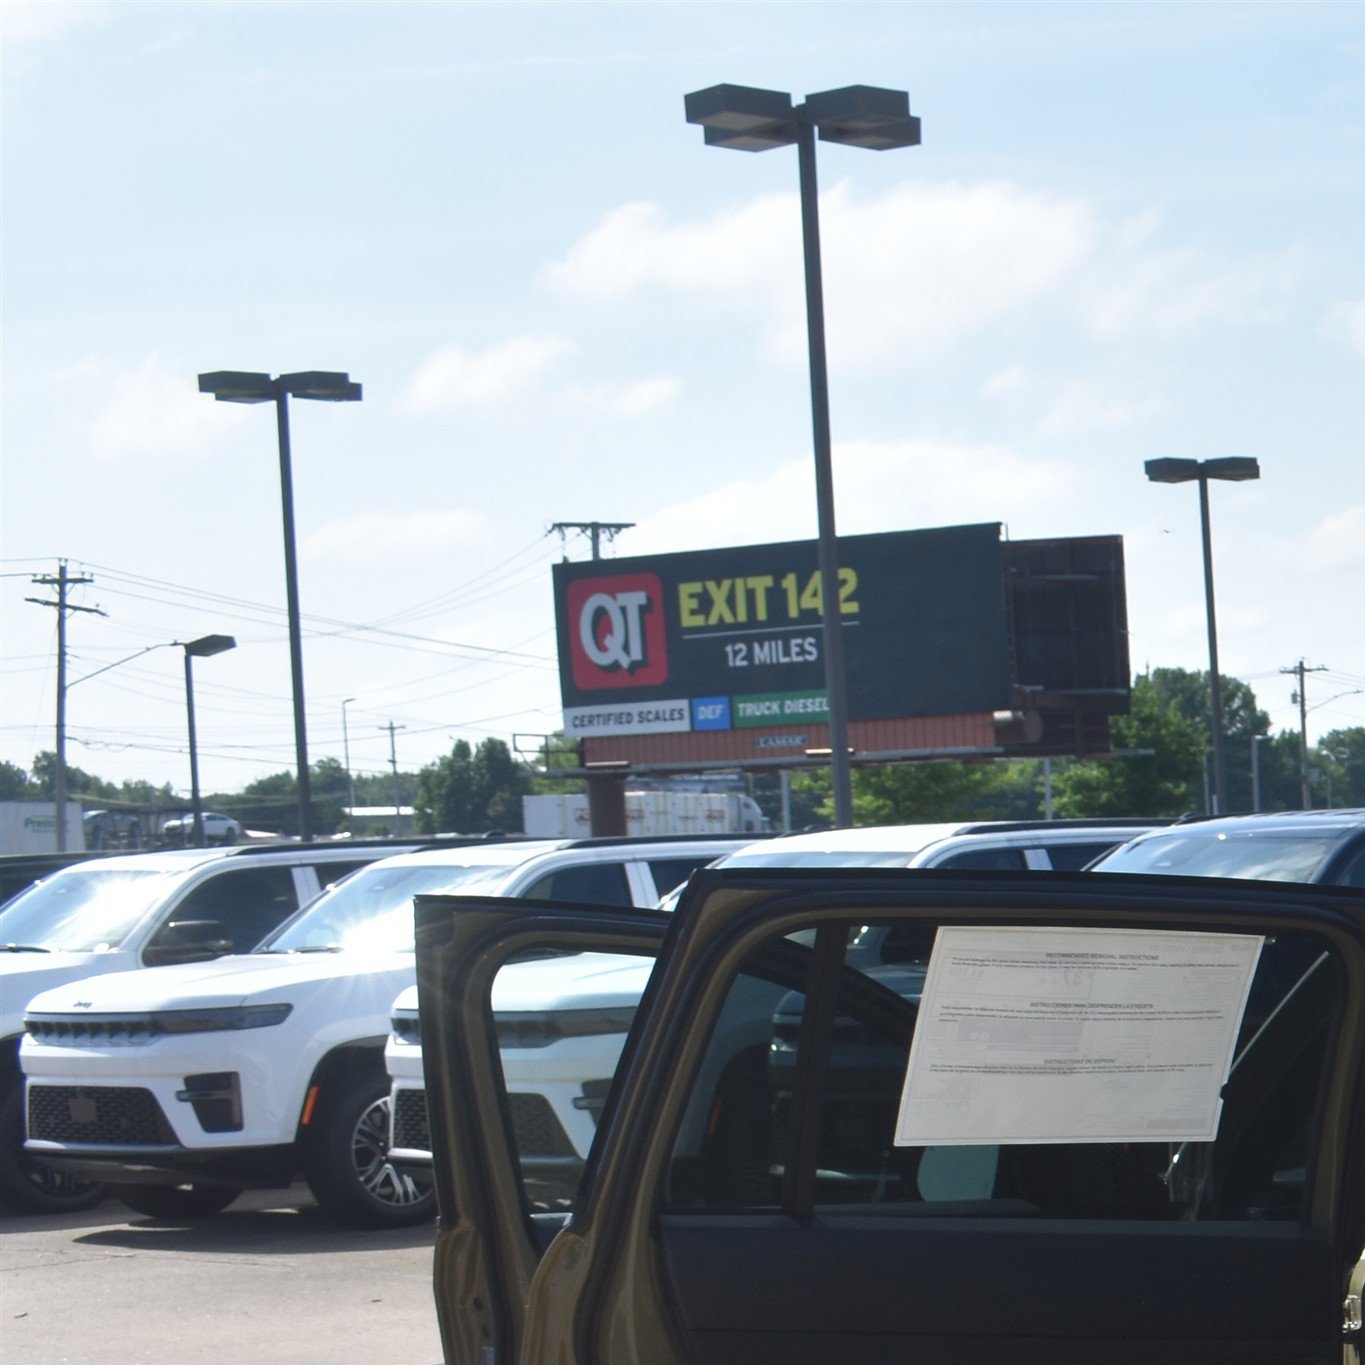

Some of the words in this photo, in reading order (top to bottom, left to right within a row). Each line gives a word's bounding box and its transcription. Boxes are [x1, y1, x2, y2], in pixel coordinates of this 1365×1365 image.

[678, 575, 774, 628] EXIT
[781, 567, 860, 619] 142
[579, 591, 648, 669] QT
[725, 643, 749, 668] 12
[754, 637, 818, 665] MILES
[572, 711, 634, 728] CERTIFIED
[637, 707, 686, 723] SCALES
[699, 704, 724, 720] DEF
[738, 701, 781, 717] TRUCK
[784, 697, 829, 713] DIESEL
